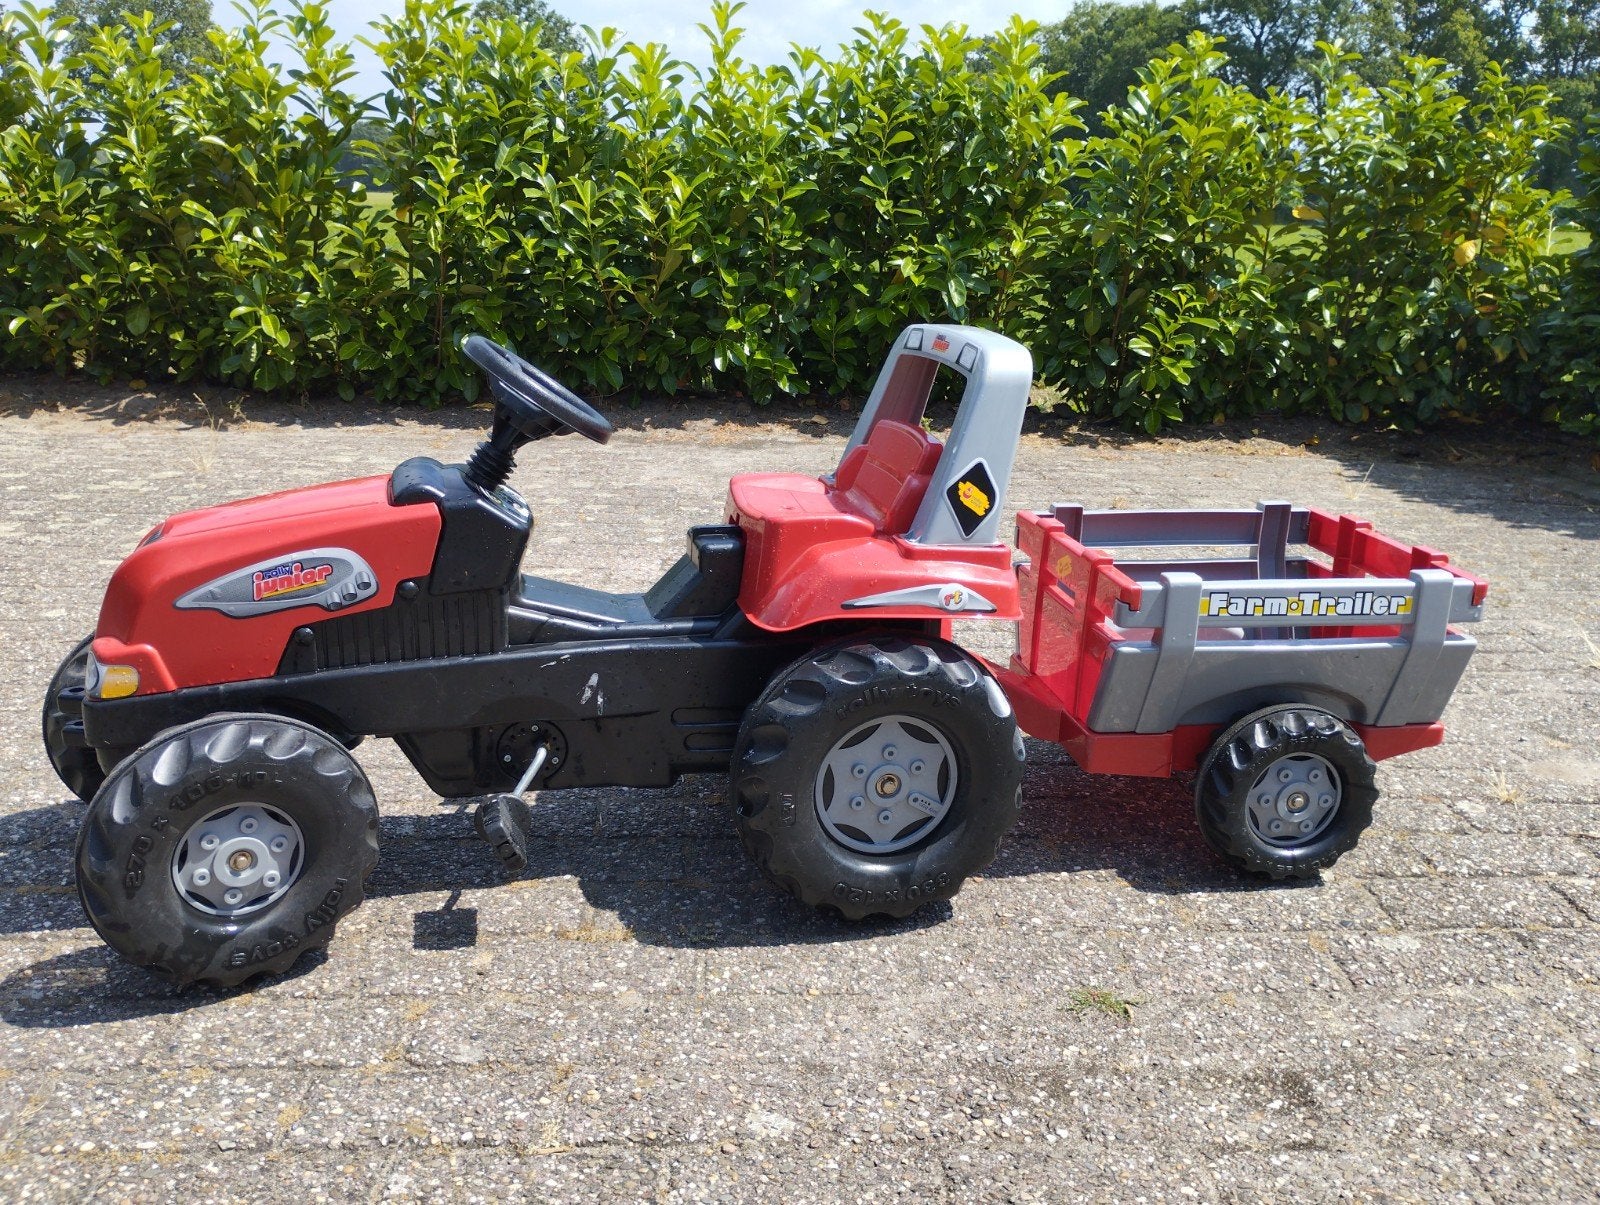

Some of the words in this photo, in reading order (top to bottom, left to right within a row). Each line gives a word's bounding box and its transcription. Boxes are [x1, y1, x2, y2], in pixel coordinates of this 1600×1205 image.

[253, 563, 332, 601] junior
[262, 565, 293, 579] rolly
[1298, 592, 1407, 616] Trailer
[836, 686, 897, 720] rolly
[904, 682, 961, 708] toys
[304, 878, 349, 934] rolly
[227, 934, 300, 969] toys
